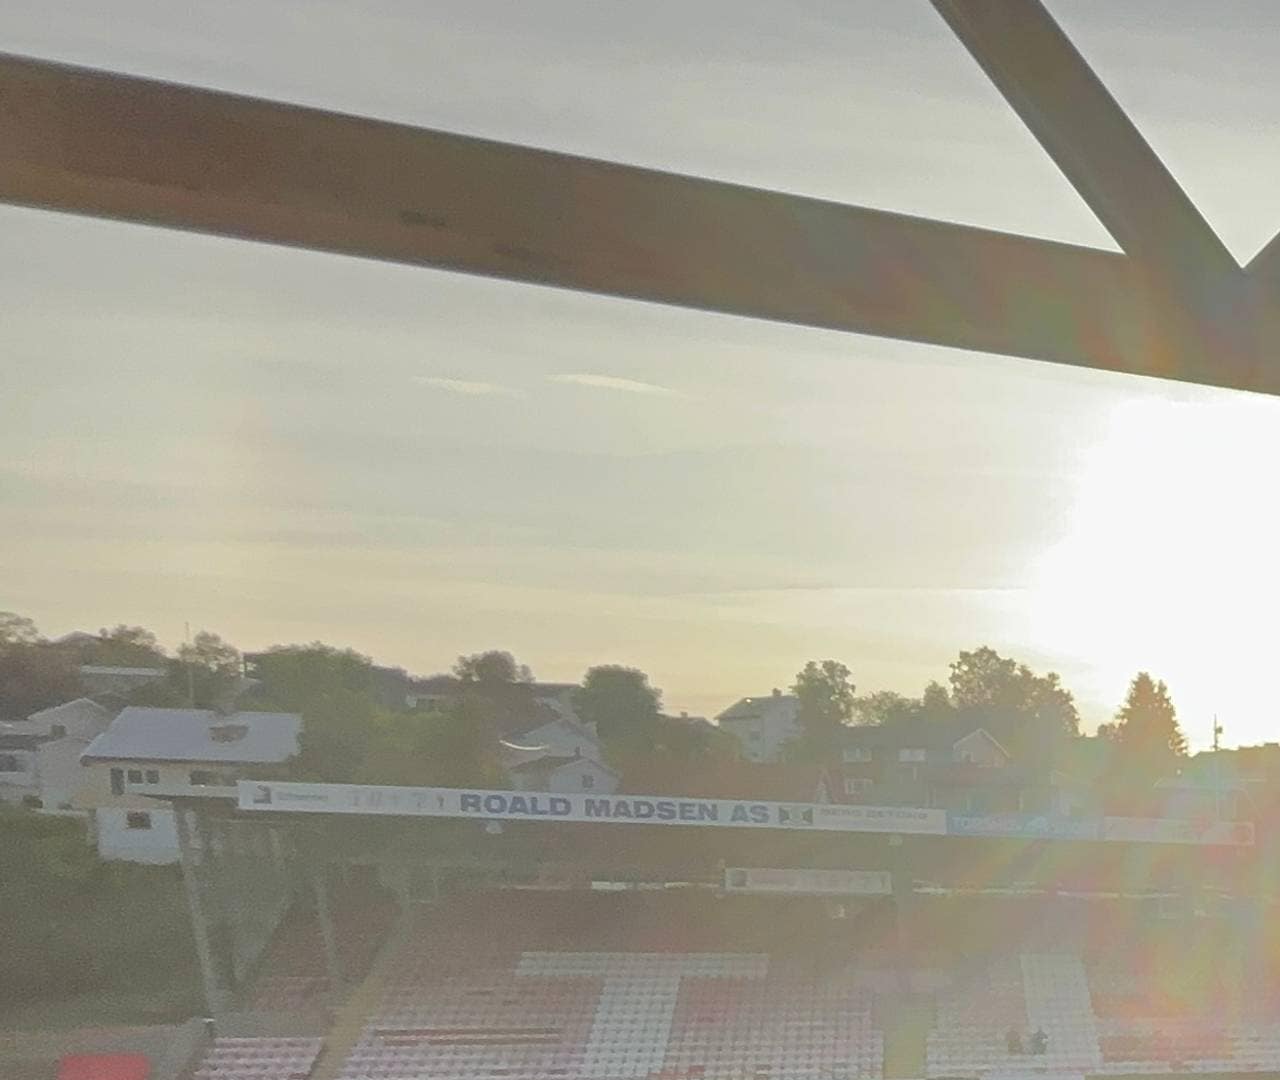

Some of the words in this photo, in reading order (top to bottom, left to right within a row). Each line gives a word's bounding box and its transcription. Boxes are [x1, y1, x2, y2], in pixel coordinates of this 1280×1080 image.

[459, 792, 572, 817] ROALD
[584, 797, 719, 823] MADSEN
[730, 804, 771, 824] AS
